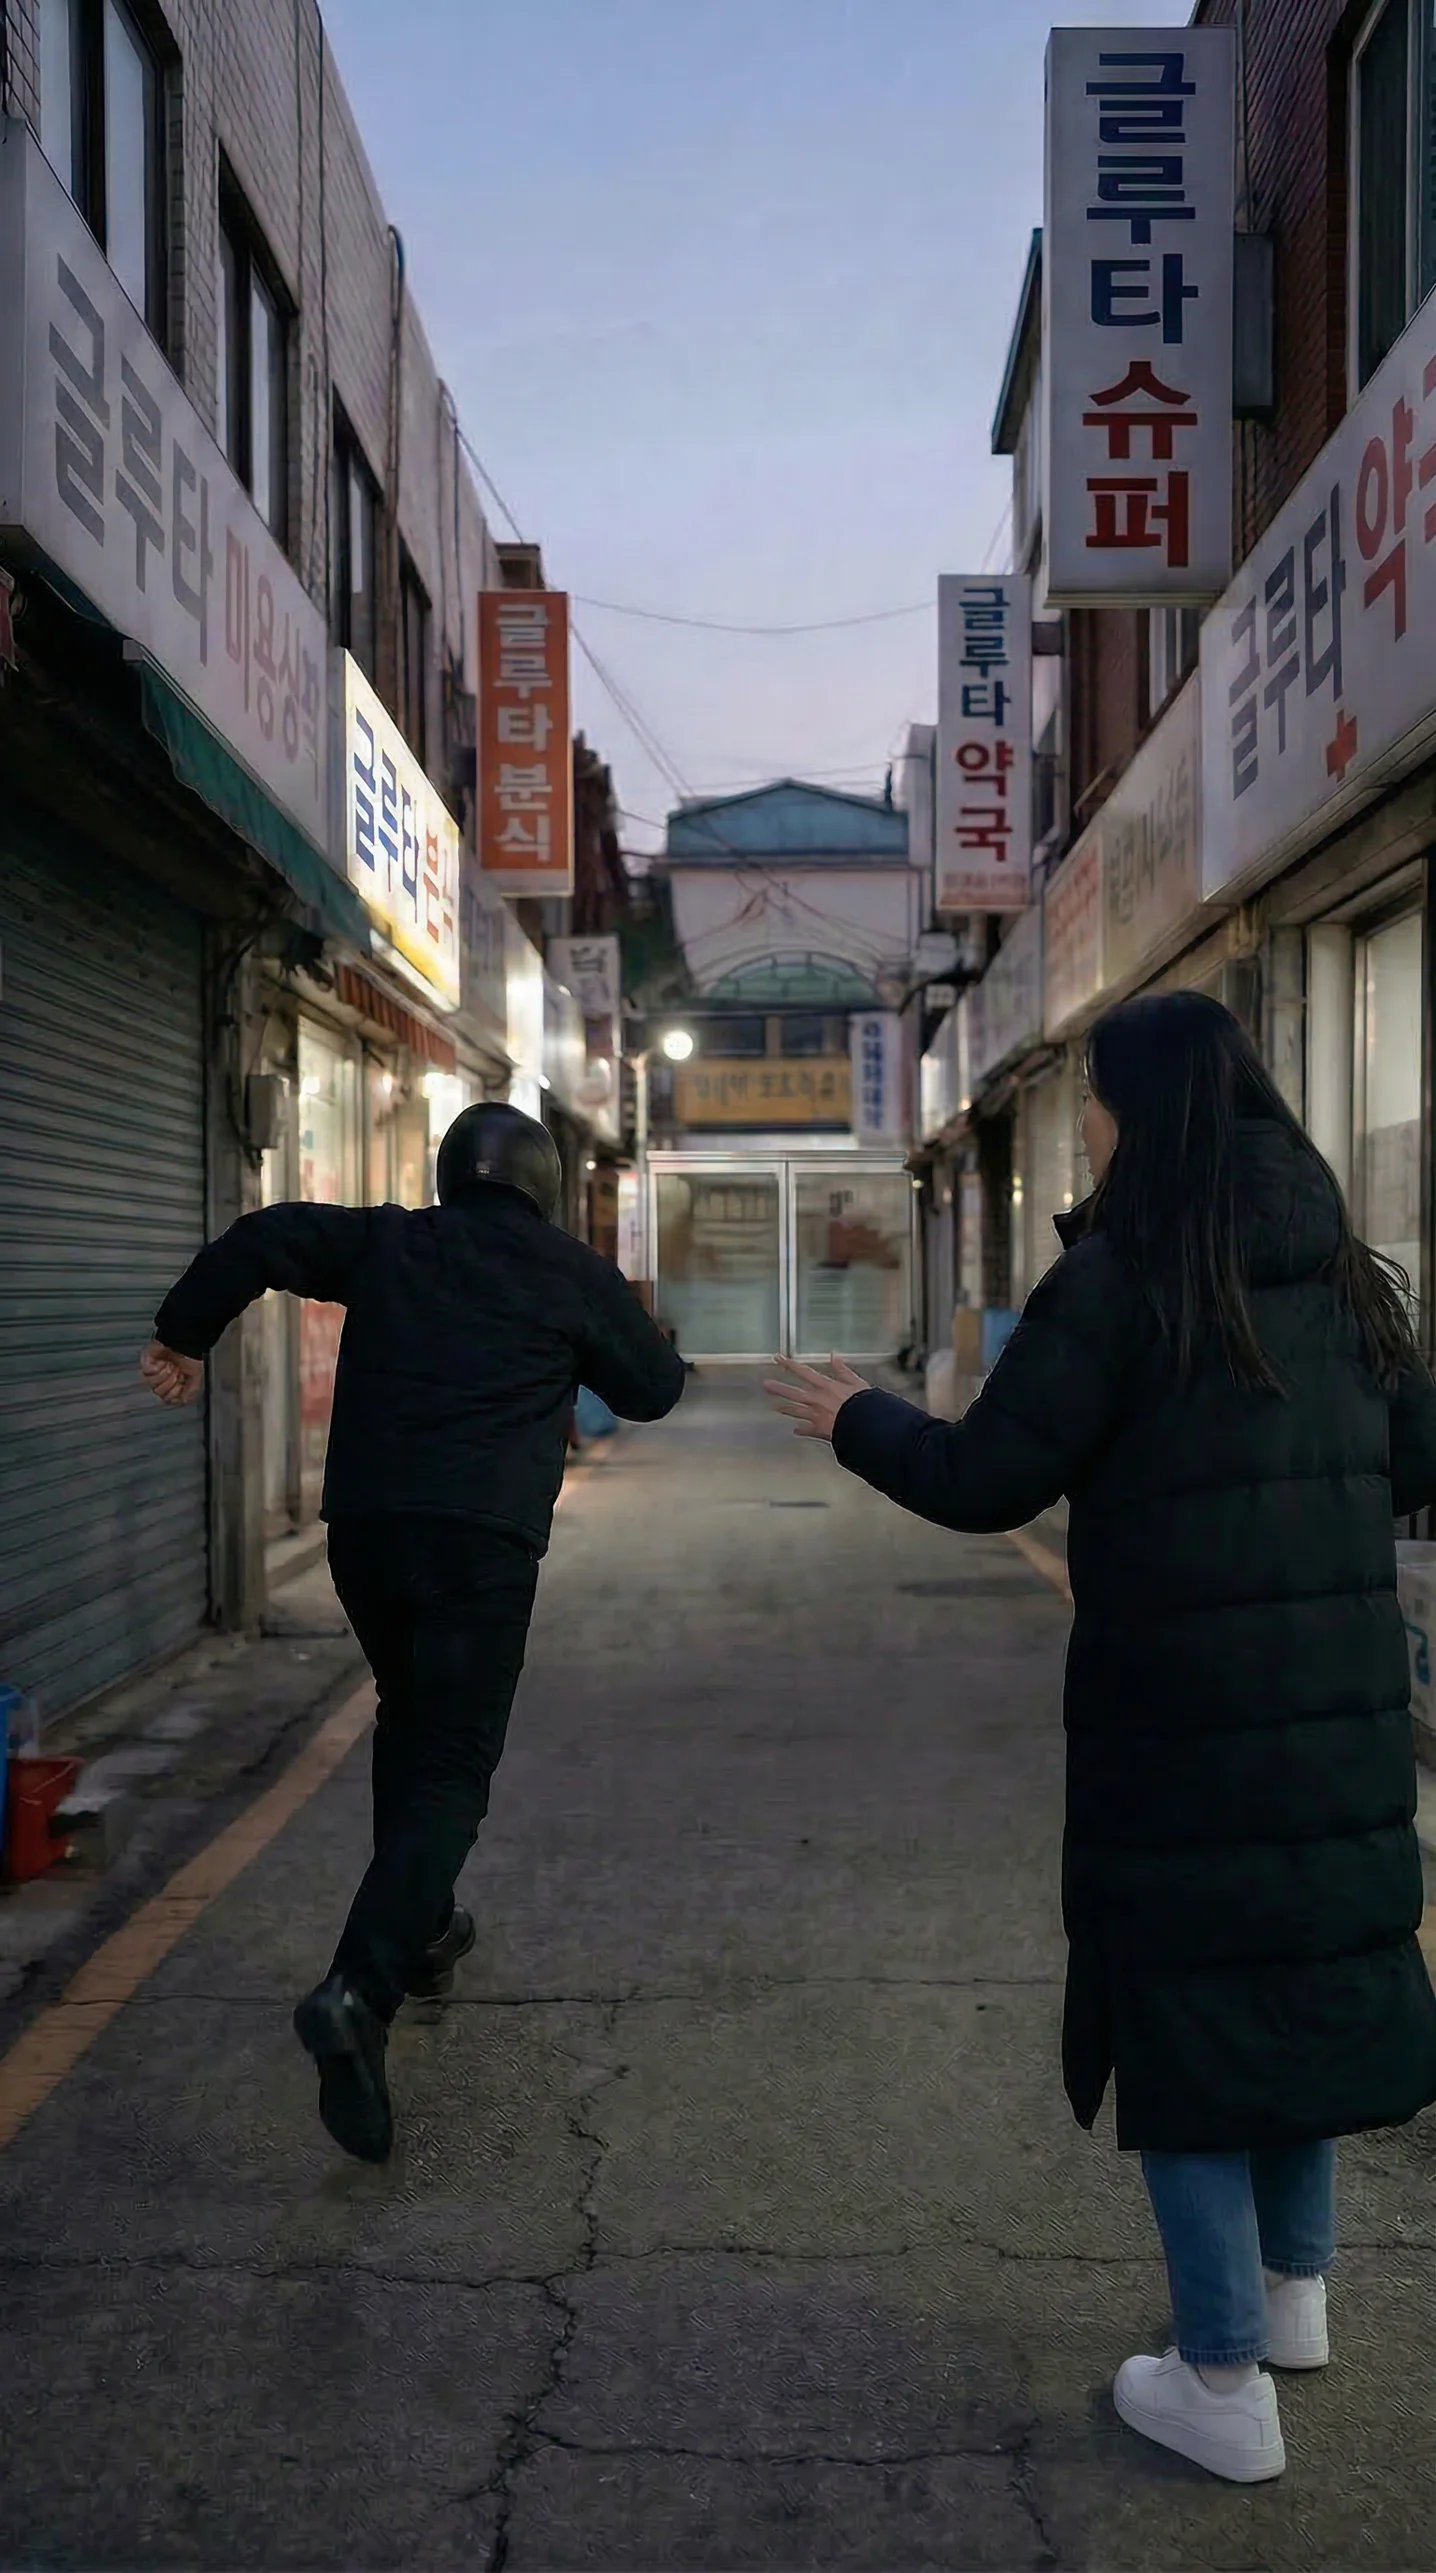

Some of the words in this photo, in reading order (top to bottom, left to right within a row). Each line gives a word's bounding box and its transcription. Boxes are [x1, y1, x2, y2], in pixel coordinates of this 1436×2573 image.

[1085, 52, 1199, 344] 글루타
[49, 252, 214, 668] 글루타
[1082, 360, 1198, 568] 슈퍼
[494, 603, 553, 752] 글루타
[959, 587, 1012, 727] 글루타
[1229, 481, 1347, 801] 글루타
[1355, 353, 1436, 643] 약
[354, 704, 420, 925] 글루타
[494, 763, 553, 862] 분식
[955, 740, 1014, 863] 약국
